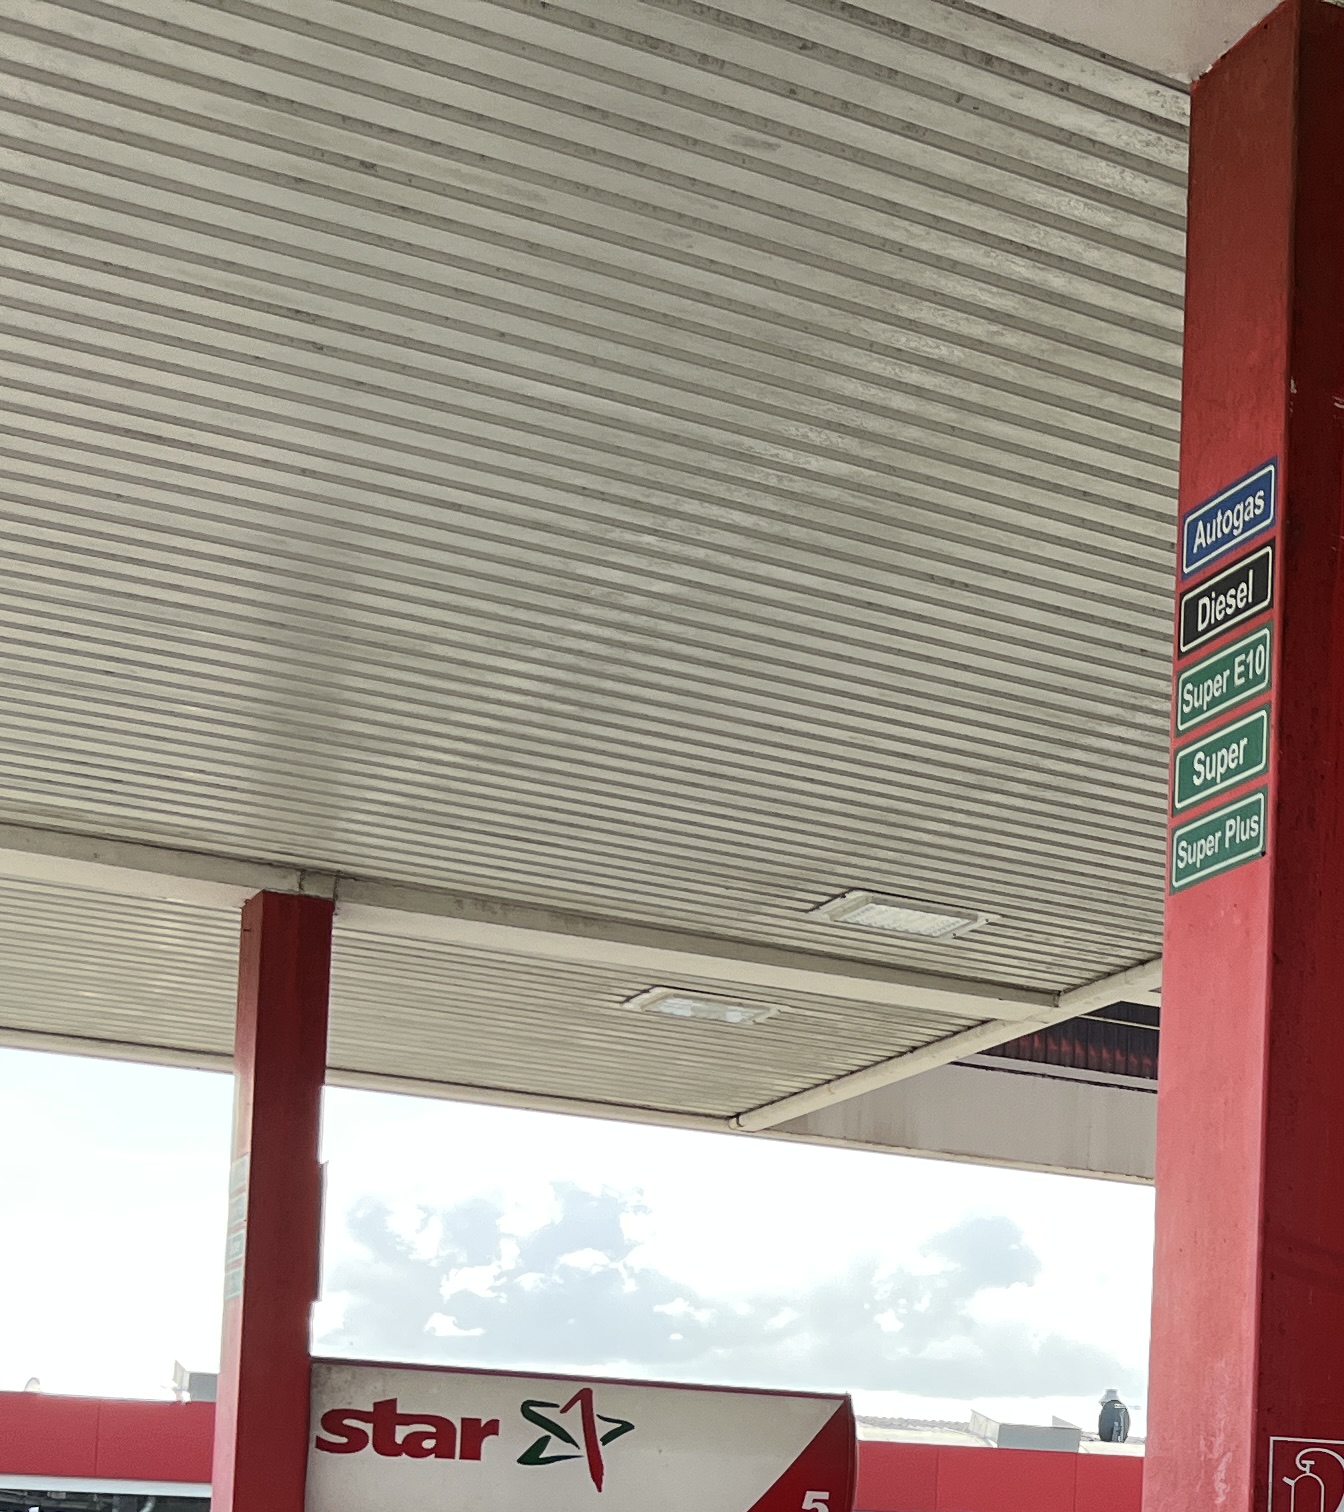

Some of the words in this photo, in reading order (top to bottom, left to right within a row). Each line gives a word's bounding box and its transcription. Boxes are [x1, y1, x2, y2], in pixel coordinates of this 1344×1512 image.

[1193, 489, 1265, 553] Autogas
[1197, 569, 1254, 632] Diesel
[1182, 666, 1230, 714] Super
[1234, 643, 1265, 687] E10
[1192, 735, 1249, 786] Super
[1177, 831, 1222, 868] Super
[1225, 813, 1260, 852] Plus
[314, 1397, 500, 1462] star
